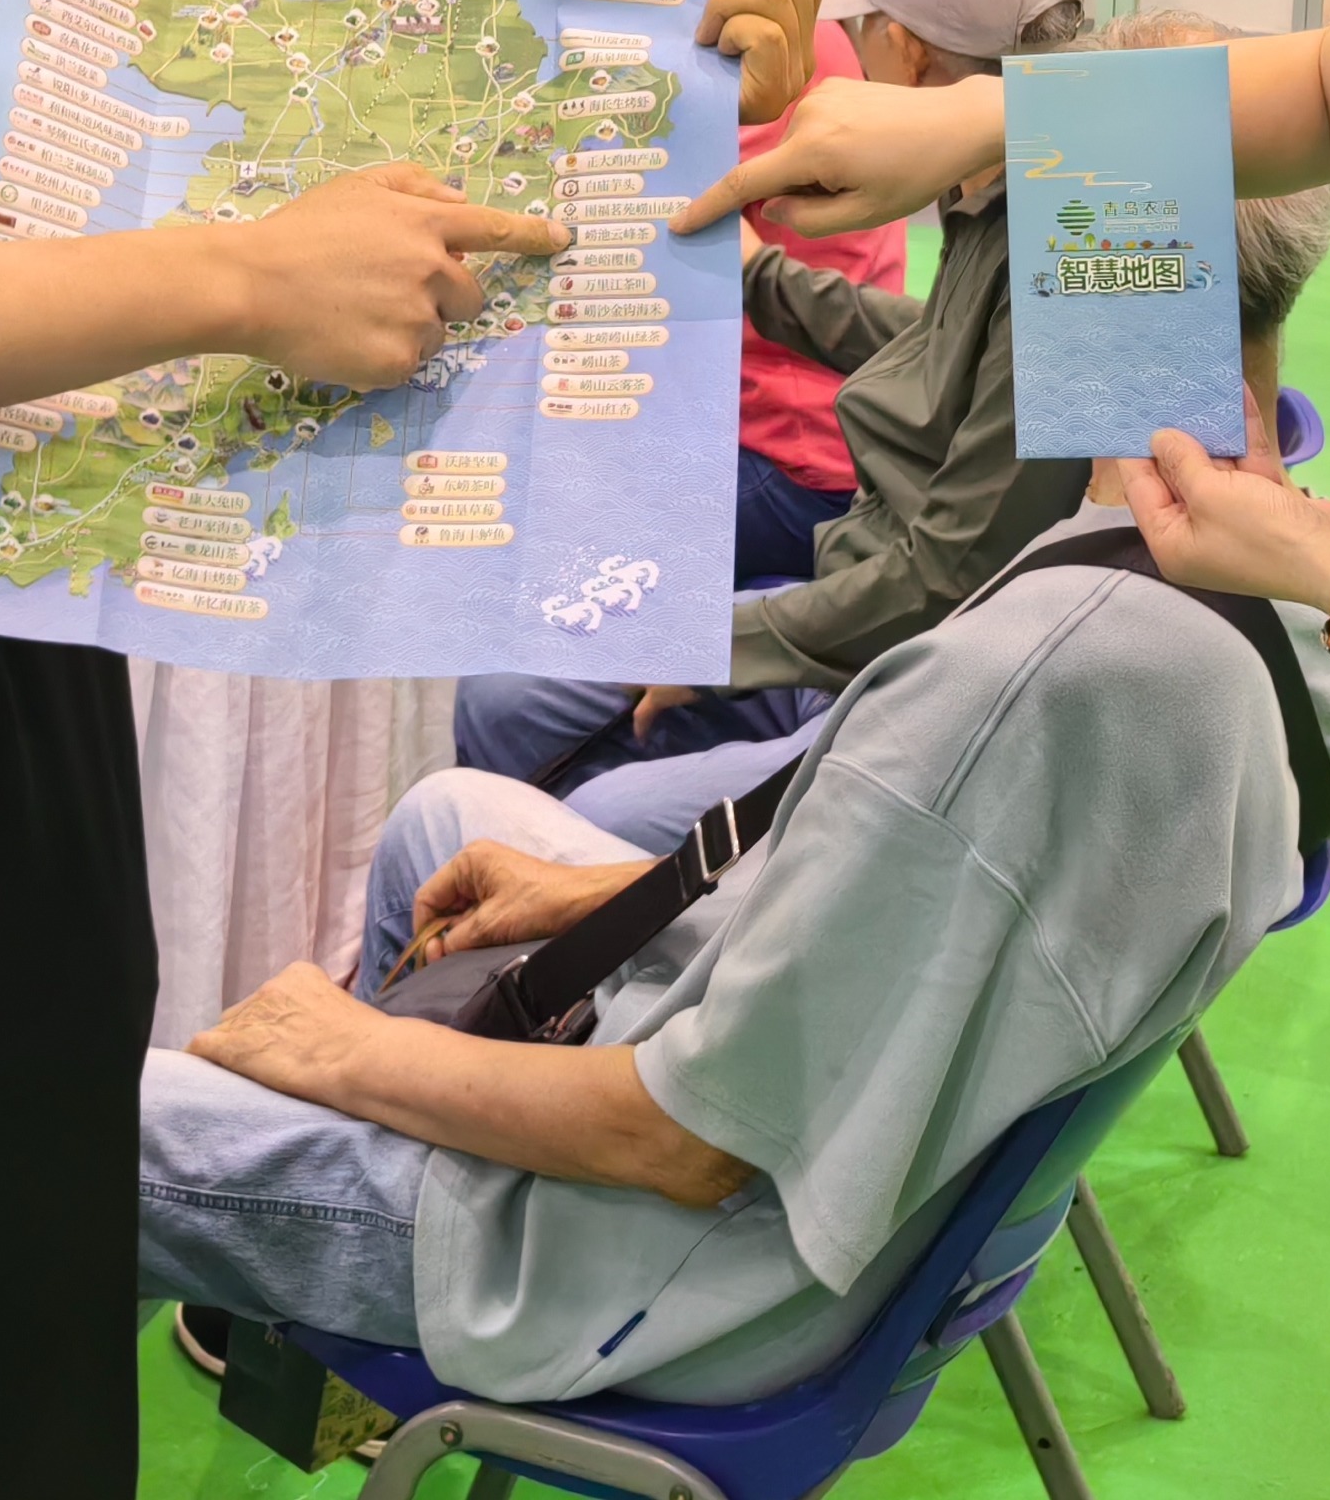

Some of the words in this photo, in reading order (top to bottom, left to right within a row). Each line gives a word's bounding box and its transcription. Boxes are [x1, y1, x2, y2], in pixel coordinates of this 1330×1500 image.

[587, 152, 663, 168] 正大鸡肉产品
[585, 177, 636, 194] 白庙芋头
[1103, 199, 1179, 217] 青岛农品
[584, 227, 650, 243] 崂池云峰茶
[1059, 255, 1185, 292] 智慧地图
[584, 277, 647, 291] 万里江茶叶
[581, 354, 621, 368] 崂山茶
[579, 378, 646, 392] 崂山云雾茶
[579, 402, 632, 416] 少山红杏
[193, 594, 261, 614] 华忆海青茶
